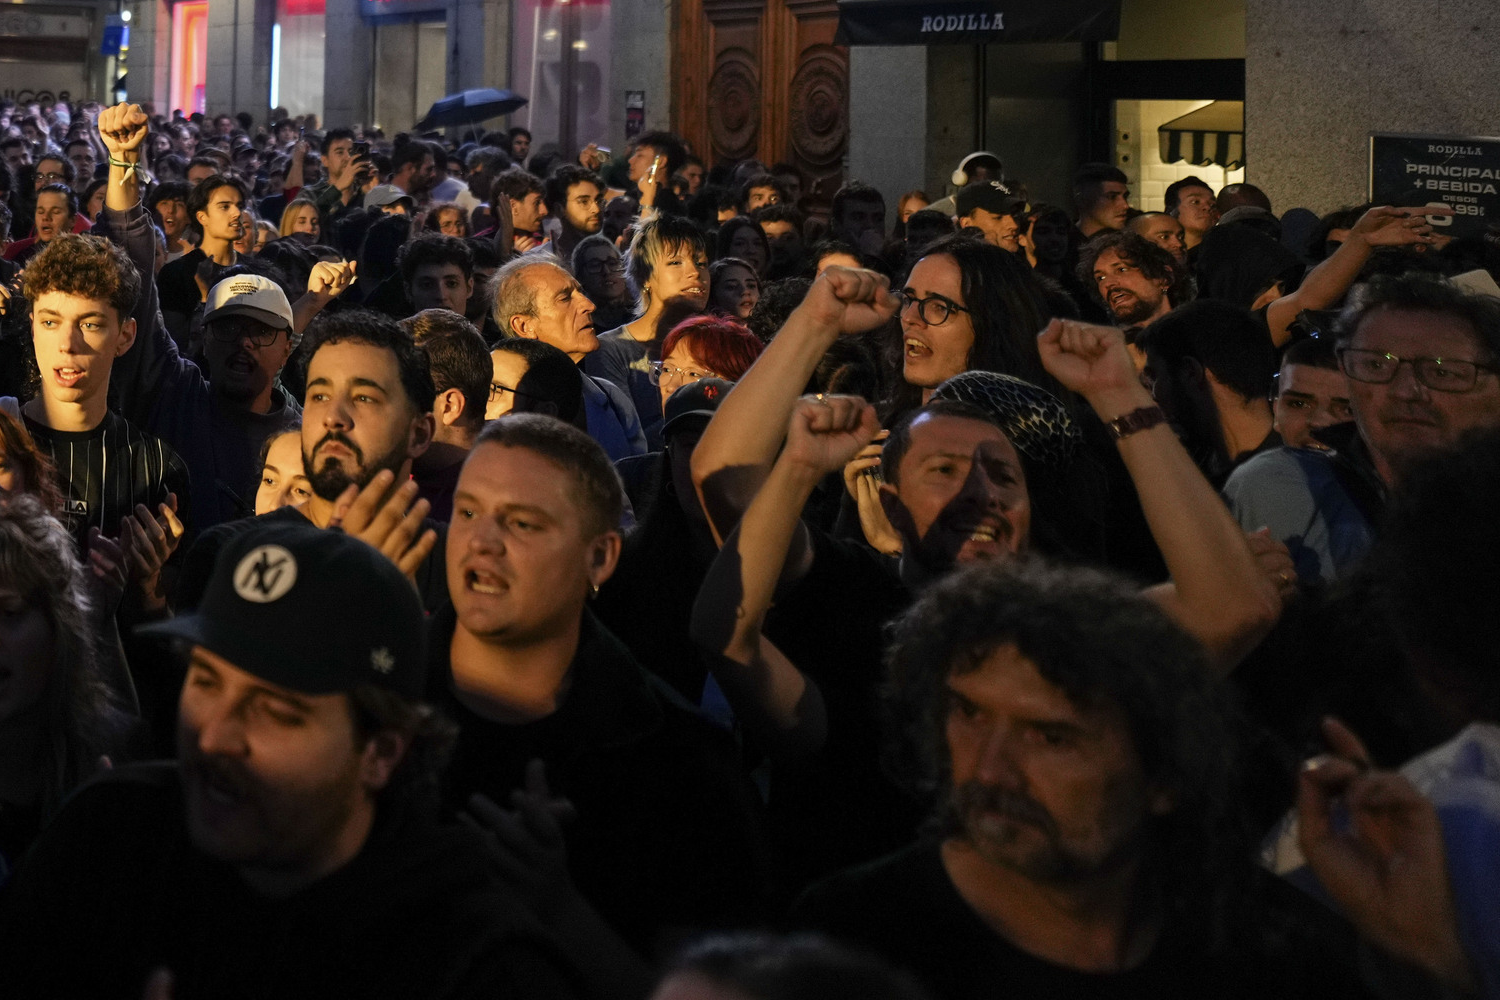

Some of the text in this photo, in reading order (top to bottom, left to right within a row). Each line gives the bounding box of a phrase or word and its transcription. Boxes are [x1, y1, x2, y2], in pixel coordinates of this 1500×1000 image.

[921, 13, 1004, 32] RODILLA
[1428, 145, 1482, 156] RODILLA
[1406, 164, 1500, 180] PRINCIPAL
[1426, 180, 1498, 195] BEBIDA
[1442, 195, 1478, 204] DESDE
